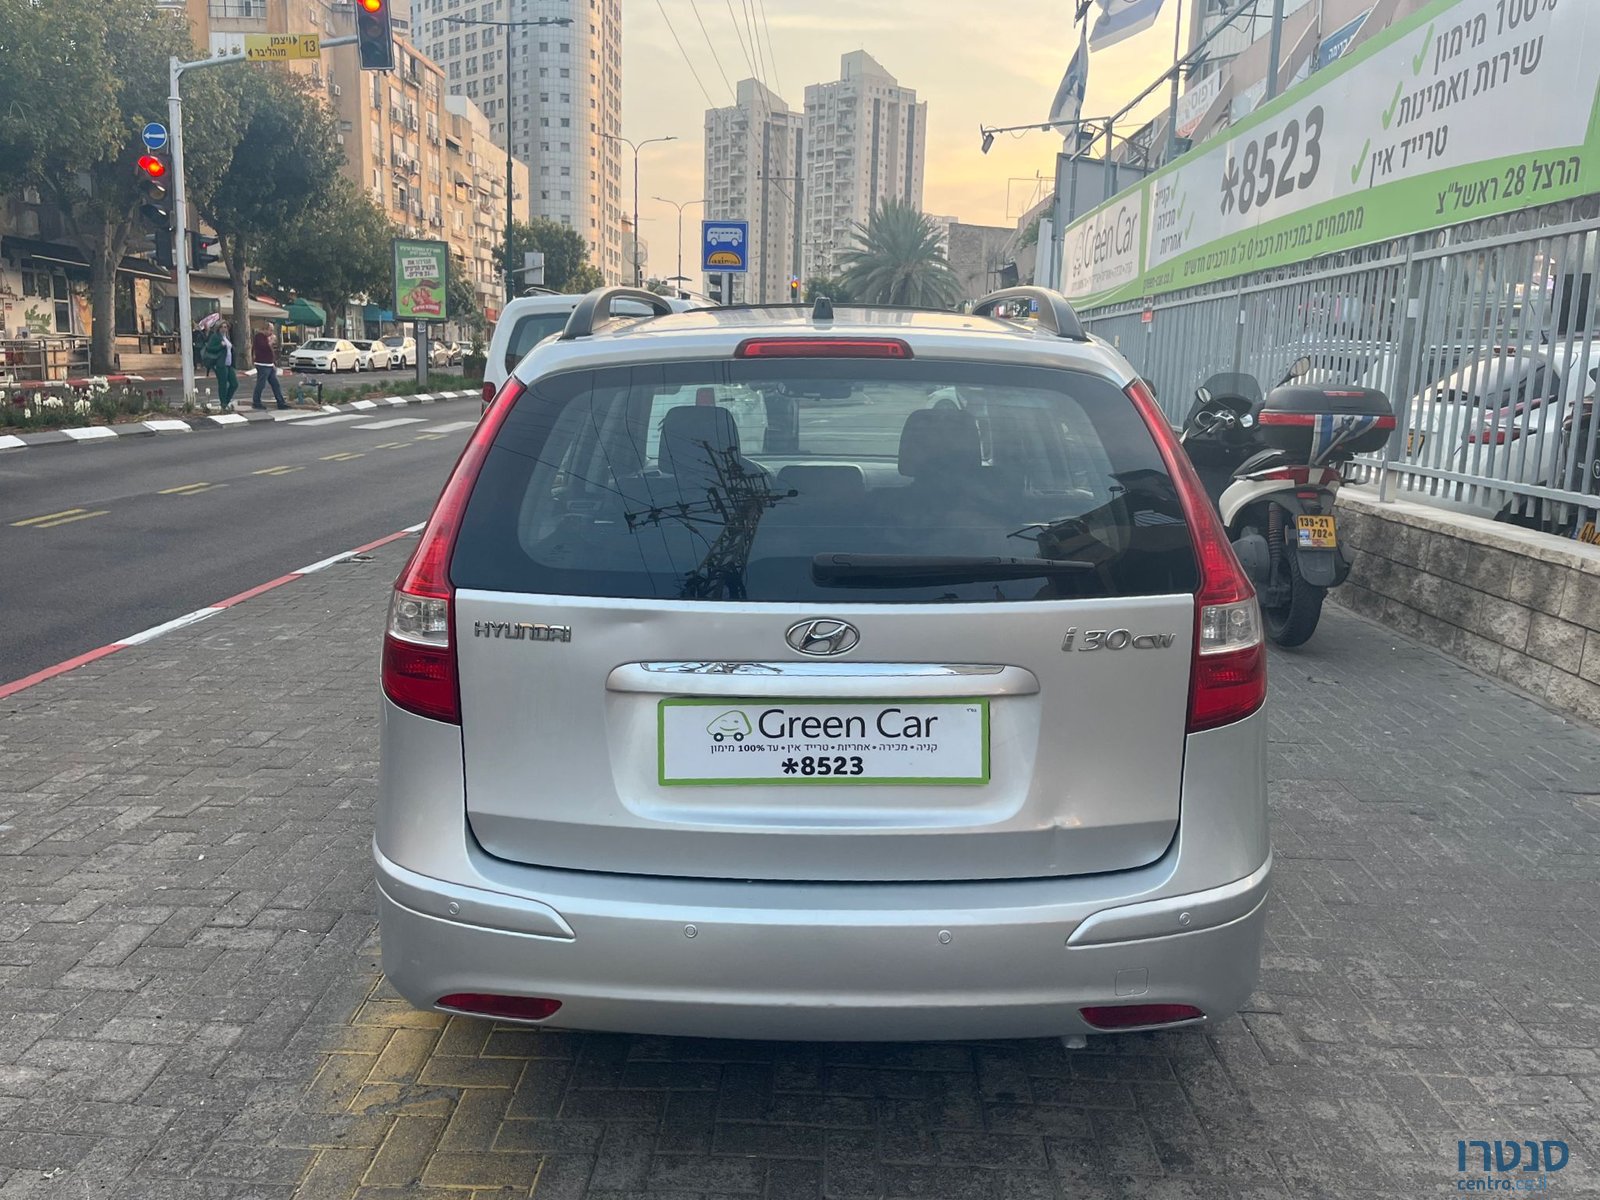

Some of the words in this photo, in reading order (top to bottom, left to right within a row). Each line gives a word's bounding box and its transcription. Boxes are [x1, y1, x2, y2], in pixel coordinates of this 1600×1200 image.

[254, 46, 287, 57] מוהליבר
[270, 36, 292, 46] ויצמן
[304, 40, 316, 53] 13
[1434, 12, 1487, 75] מימון
[1472, 35, 1544, 97] שירות
[1397, 68, 1469, 128] ואמינות
[1400, 124, 1448, 169] טרייד
[1369, 144, 1395, 189] אין
[1532, 156, 1581, 192] הרצל
[1502, 164, 1526, 199] 28
[1435, 176, 1498, 215] ראשל"צ
[1157, 208, 1176, 232] מכירה
[1315, 206, 1364, 241] מתמחים
[1083, 224, 1114, 269] Green
[1115, 206, 1138, 256] Car
[1275, 222, 1312, 255] במכירת
[1311, 529, 1328, 539] 702
[474, 620, 571, 642] HYUNDAI
[758, 708, 866, 739] Green
[876, 708, 938, 739] Car
[710, 744, 735, 755] מימון
[738, 744, 766, 752] 100%
[767, 744, 779, 752] עד
[787, 744, 801, 754] אין
[804, 744, 829, 752] טרייד
[837, 743, 870, 752] אחריות
[878, 743, 908, 752] מכירה
[916, 743, 938, 753] קניה
